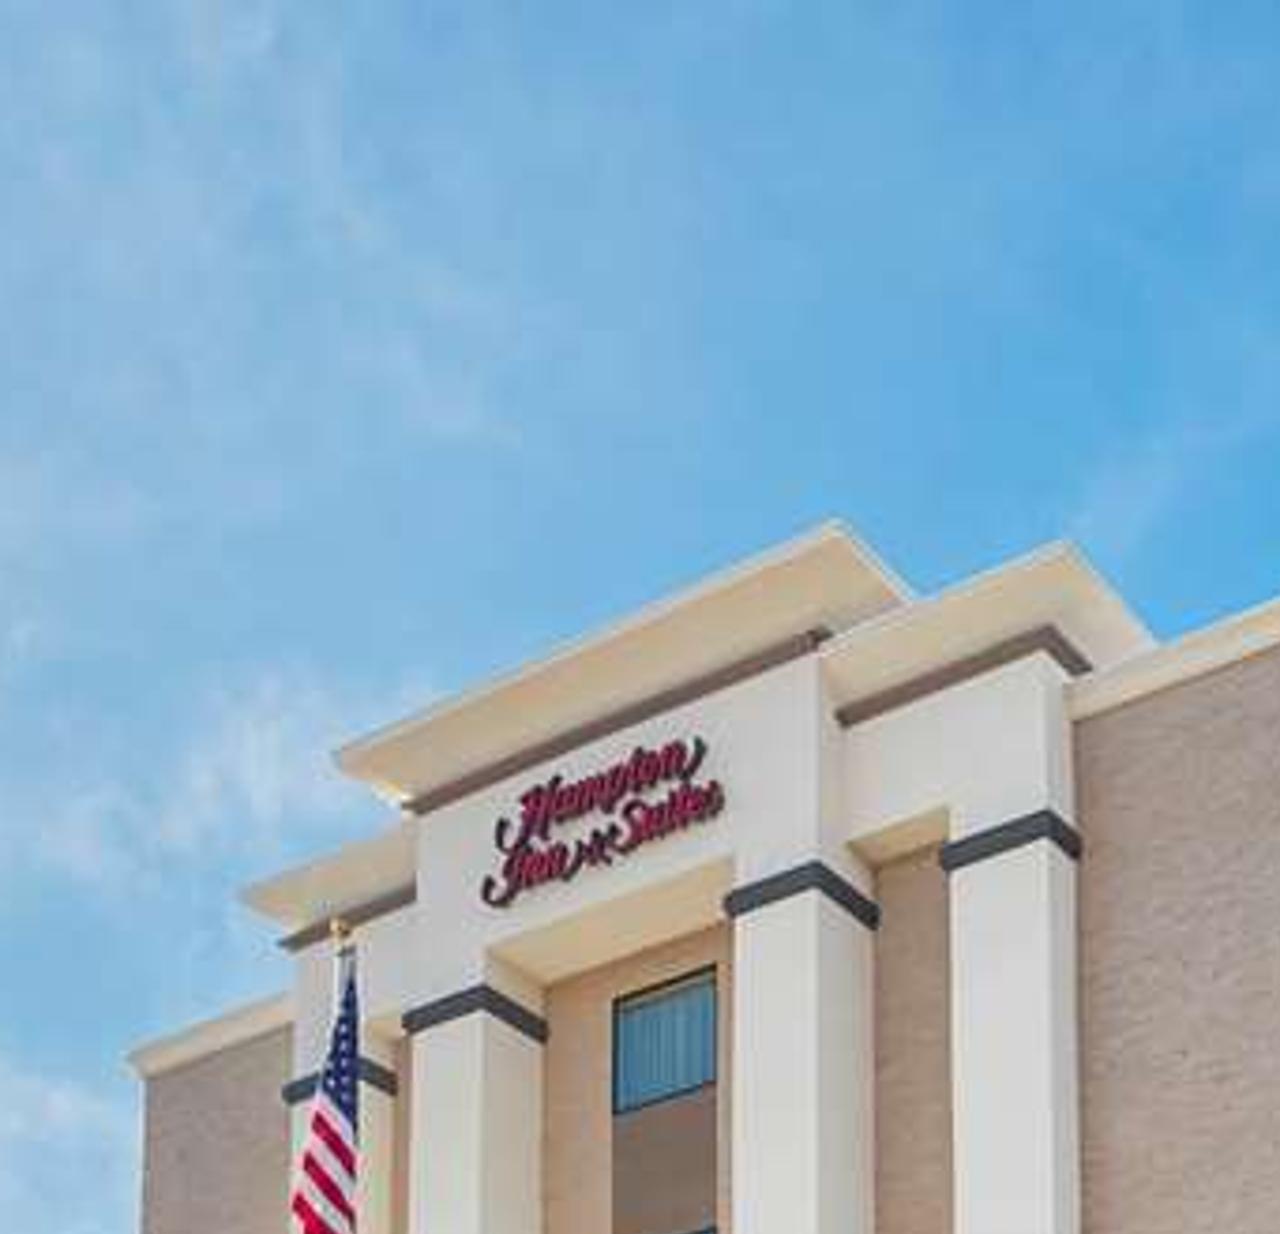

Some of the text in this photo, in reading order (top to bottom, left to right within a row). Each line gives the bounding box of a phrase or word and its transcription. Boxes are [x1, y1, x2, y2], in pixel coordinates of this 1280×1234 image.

[481, 843, 586, 906] Inn
[608, 780, 725, 854] Suites
[495, 737, 707, 853] Hampton
